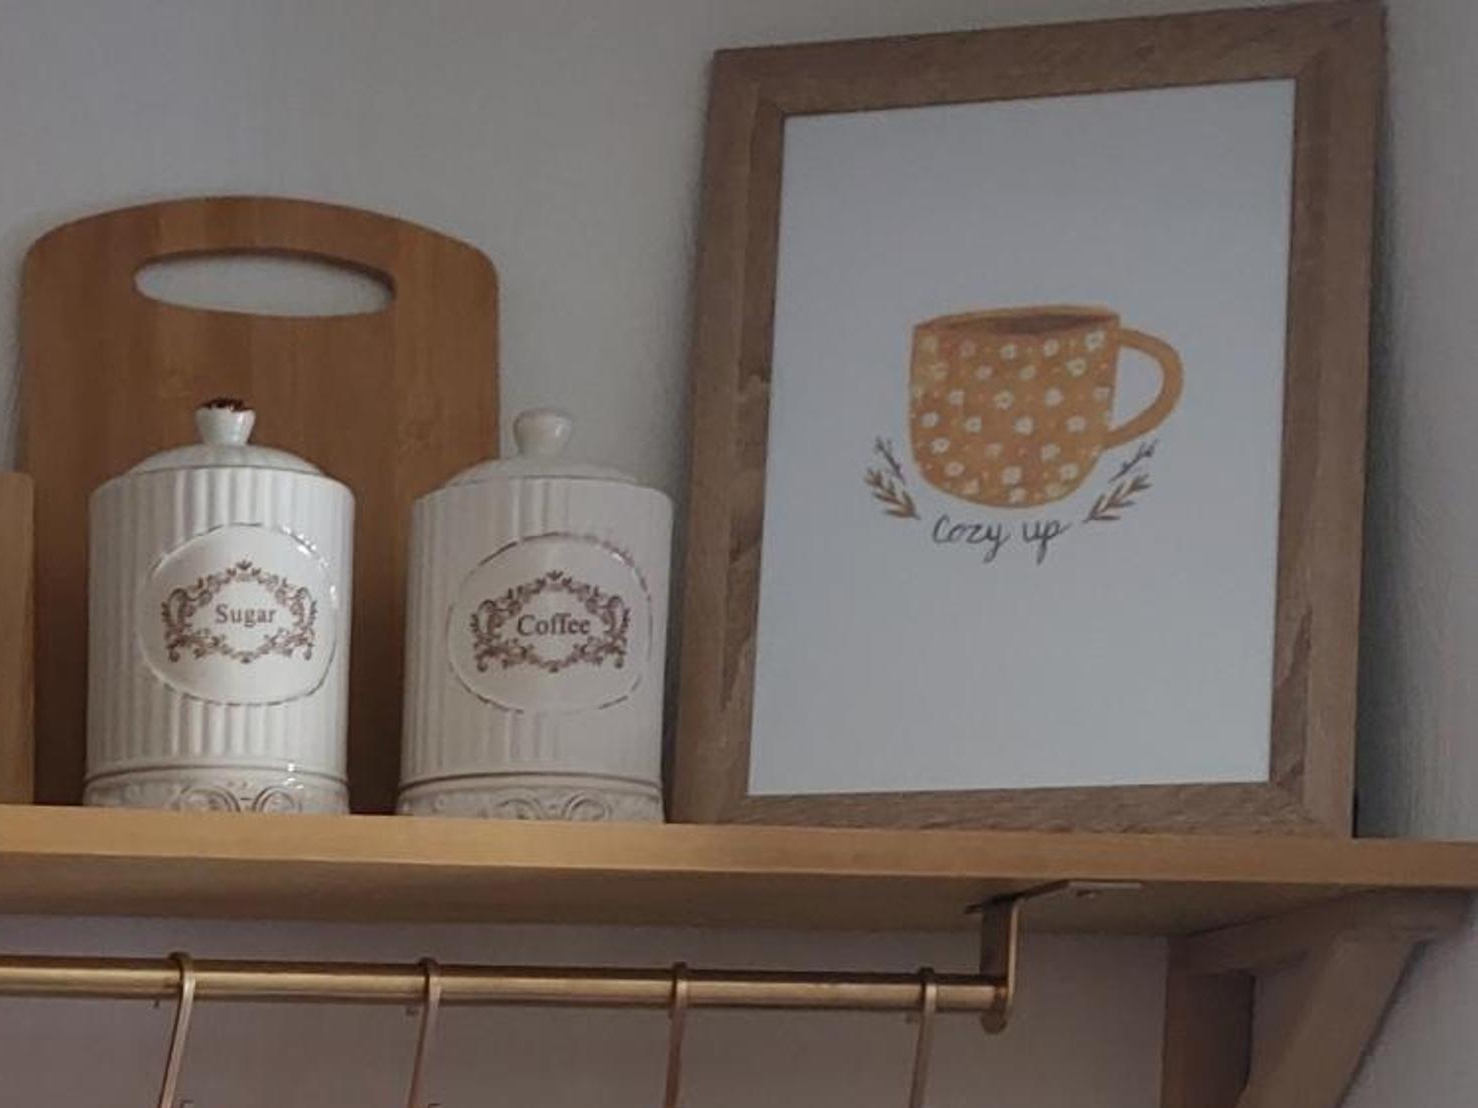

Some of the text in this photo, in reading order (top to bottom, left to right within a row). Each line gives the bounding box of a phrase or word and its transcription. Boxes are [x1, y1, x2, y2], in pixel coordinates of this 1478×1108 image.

[932, 514, 1071, 565] Cozy up
[215, 603, 276, 628] Sugar
[517, 612, 591, 636] Coffee
